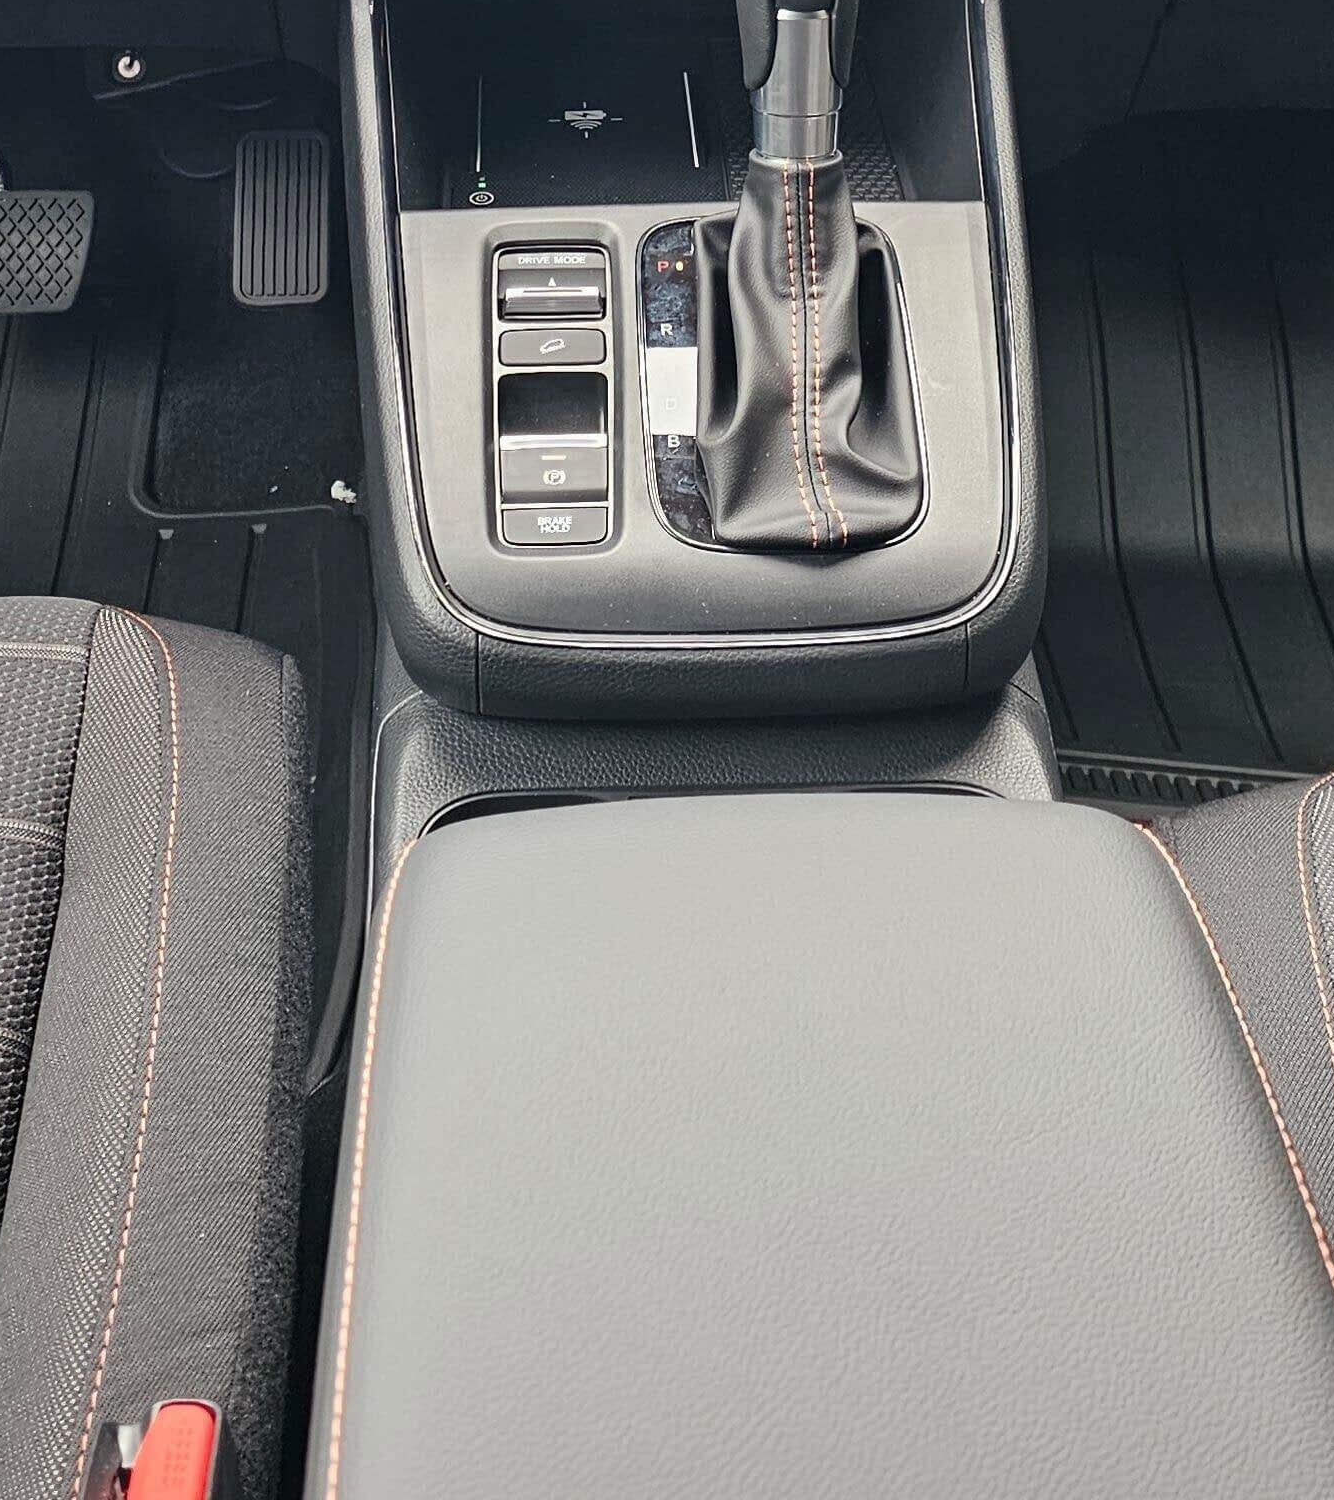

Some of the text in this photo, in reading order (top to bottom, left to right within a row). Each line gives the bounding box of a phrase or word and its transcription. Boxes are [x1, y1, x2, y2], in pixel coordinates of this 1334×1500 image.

[518, 254, 586, 265] DRIVE MODE
[657, 261, 670, 273] P
[660, 323, 674, 336] R
[667, 435, 681, 448] B
[537, 515, 572, 526] BRAKE
[540, 524, 571, 533] HOLD
